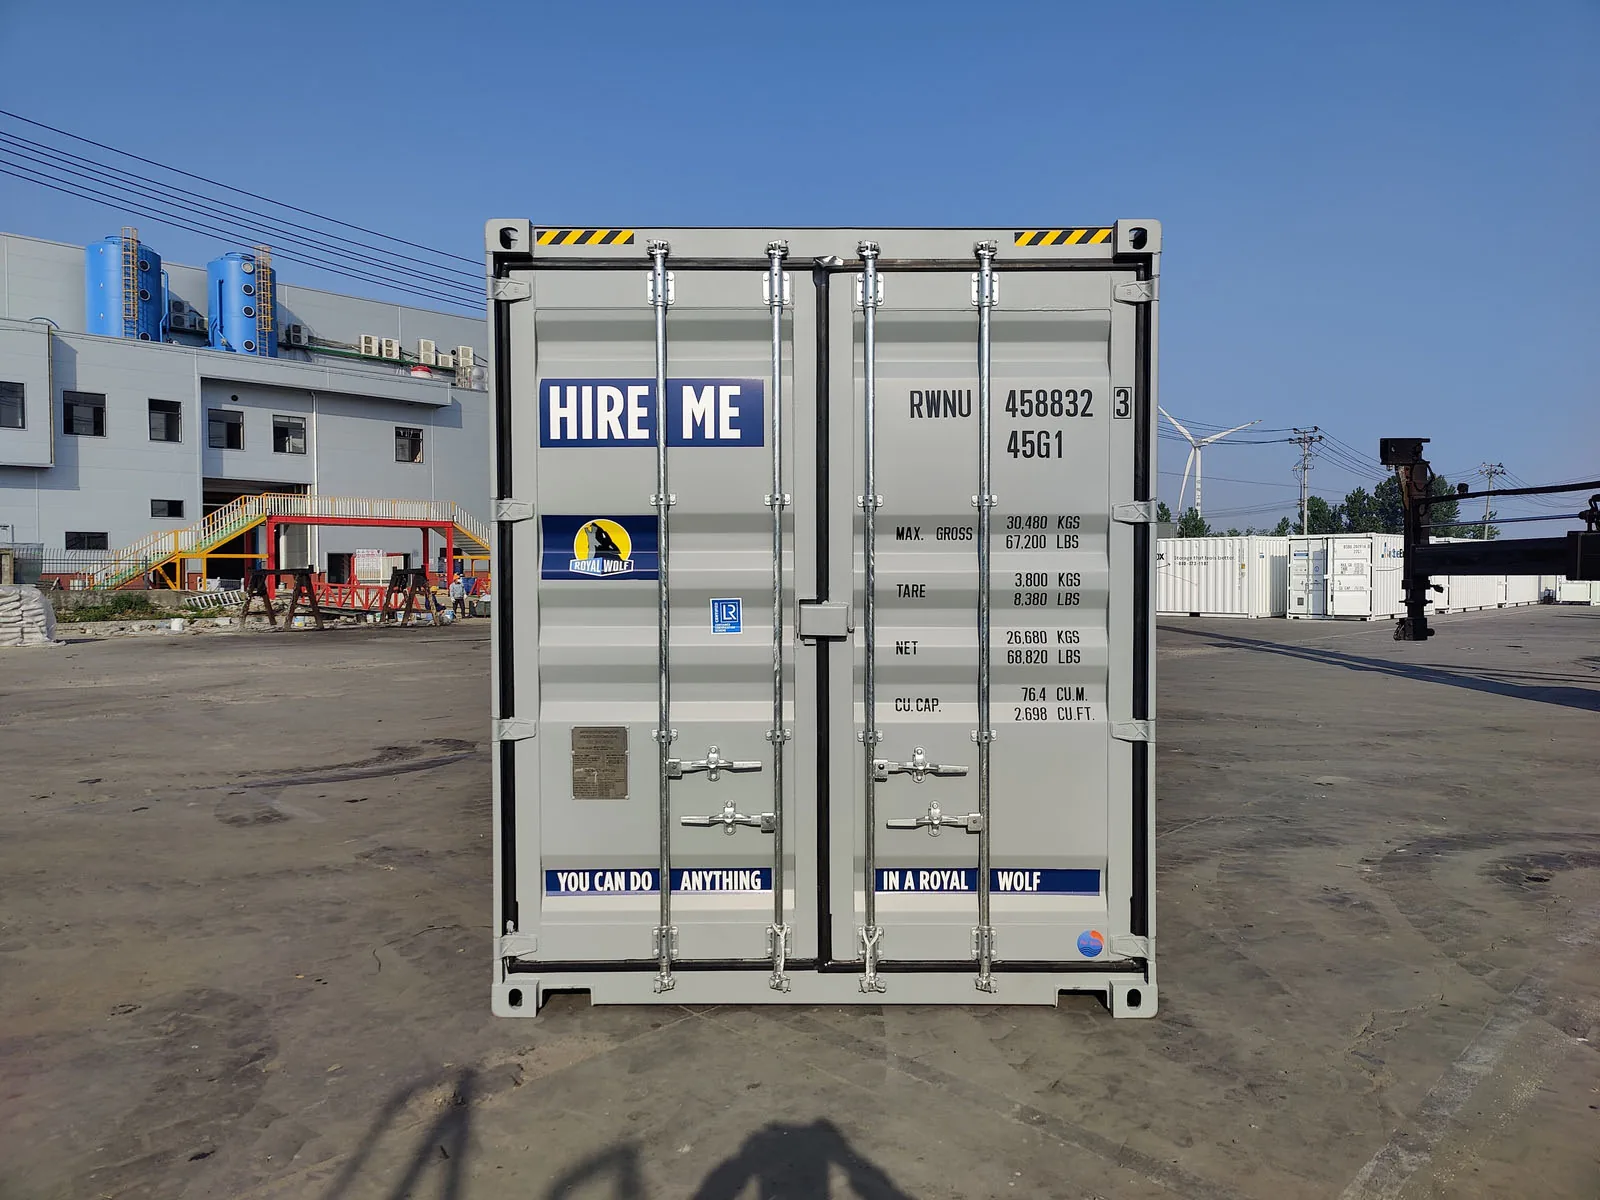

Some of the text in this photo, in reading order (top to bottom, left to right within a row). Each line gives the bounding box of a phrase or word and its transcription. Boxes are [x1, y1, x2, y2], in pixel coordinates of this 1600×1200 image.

[910, 389, 1129, 418] RWNU 458832 3
[549, 386, 741, 440] HIRE ME
[1006, 430, 1063, 458] 45G1
[1057, 516, 1080, 530] KGS
[896, 526, 973, 541] MAX. GROSS
[1056, 534, 1079, 549] LBS
[574, 560, 629, 573] ROYAL WOLF
[1058, 573, 1081, 587] KGS
[896, 584, 926, 598] TARE
[1057, 592, 1080, 606] LBS
[723, 604, 737, 620] LR
[1057, 630, 1080, 644] KGS
[895, 641, 918, 655] NET
[1058, 649, 1081, 664] LBS
[1021, 687, 1046, 701] 76.4
[557, 871, 1040, 892] YOU CAN DO ANYTHING IN A ROYAL WOLF
